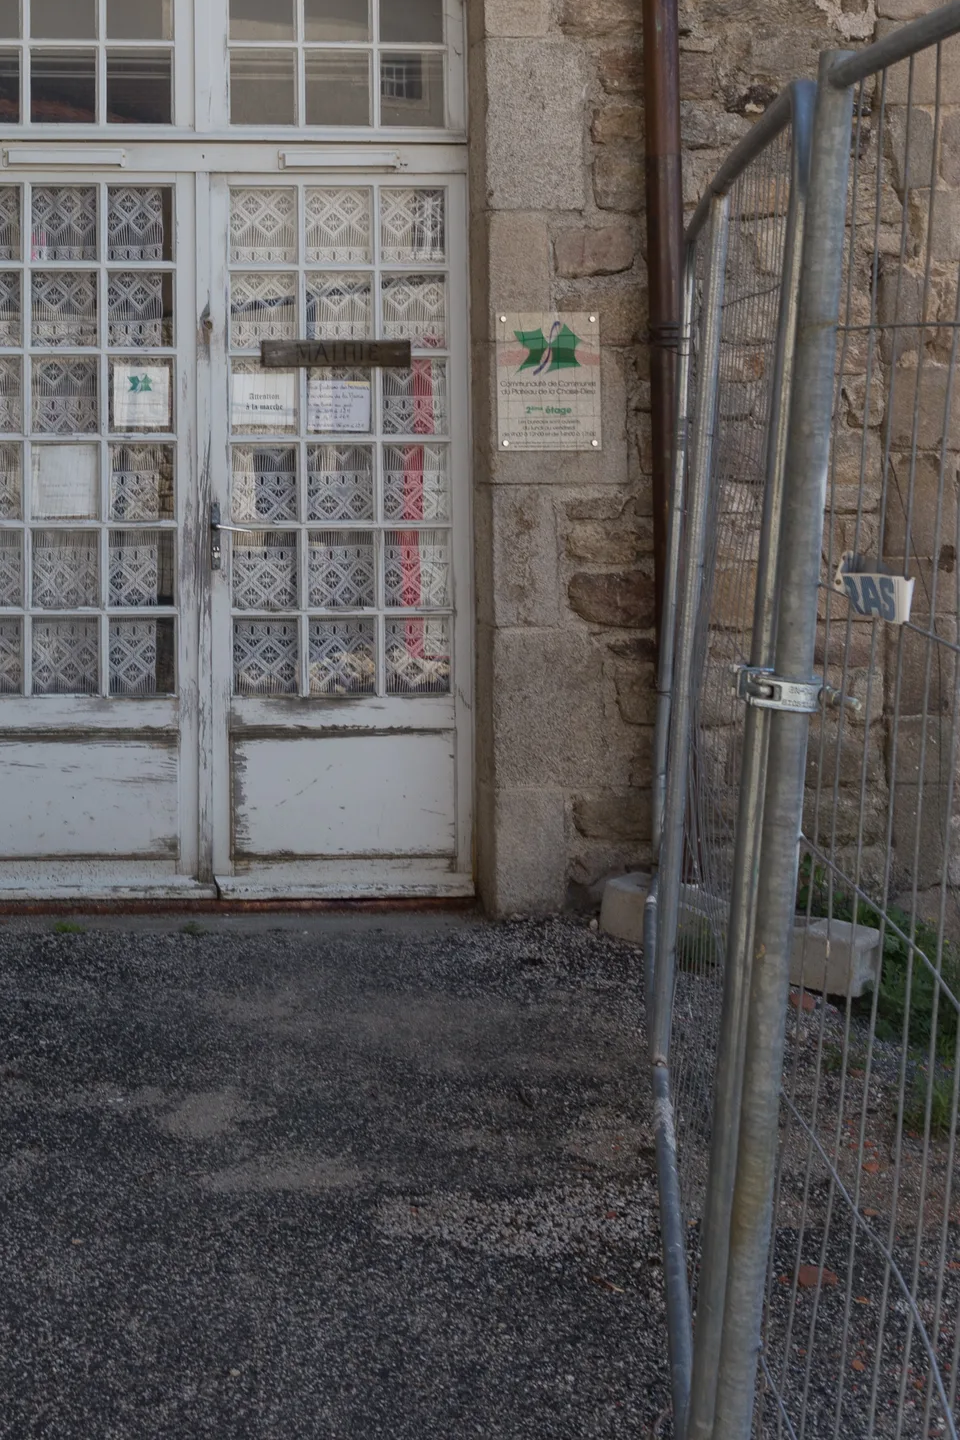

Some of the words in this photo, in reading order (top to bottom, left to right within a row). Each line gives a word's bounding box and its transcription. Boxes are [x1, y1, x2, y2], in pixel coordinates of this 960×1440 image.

[500, 380, 546, 388] Communauté
[259, 403, 284, 411] marche
[545, 405, 572, 415] étage
